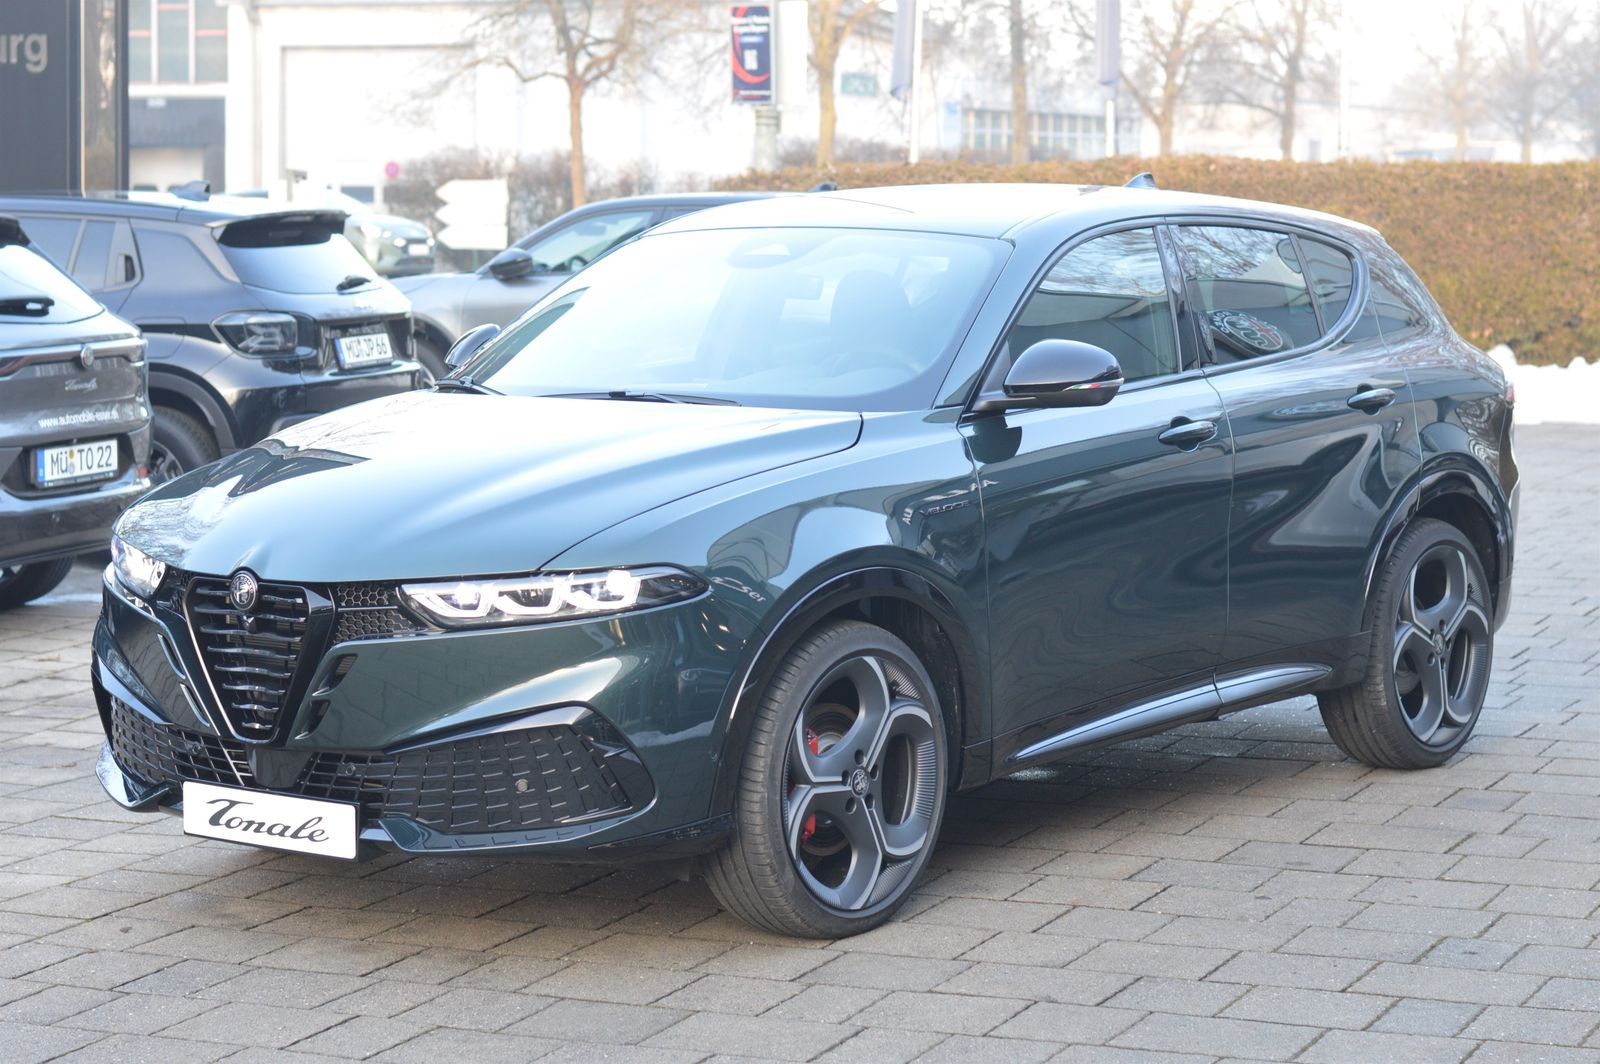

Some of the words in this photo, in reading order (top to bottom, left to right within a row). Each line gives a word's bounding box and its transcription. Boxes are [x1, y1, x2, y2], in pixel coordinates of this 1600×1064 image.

[376, 336, 388, 356] 66
[50, 451, 68, 477] MÜ
[77, 447, 94, 472] TO
[97, 445, 112, 468] 22
[919, 500, 971, 517] VELOCE
[206, 798, 330, 843] Tonale
